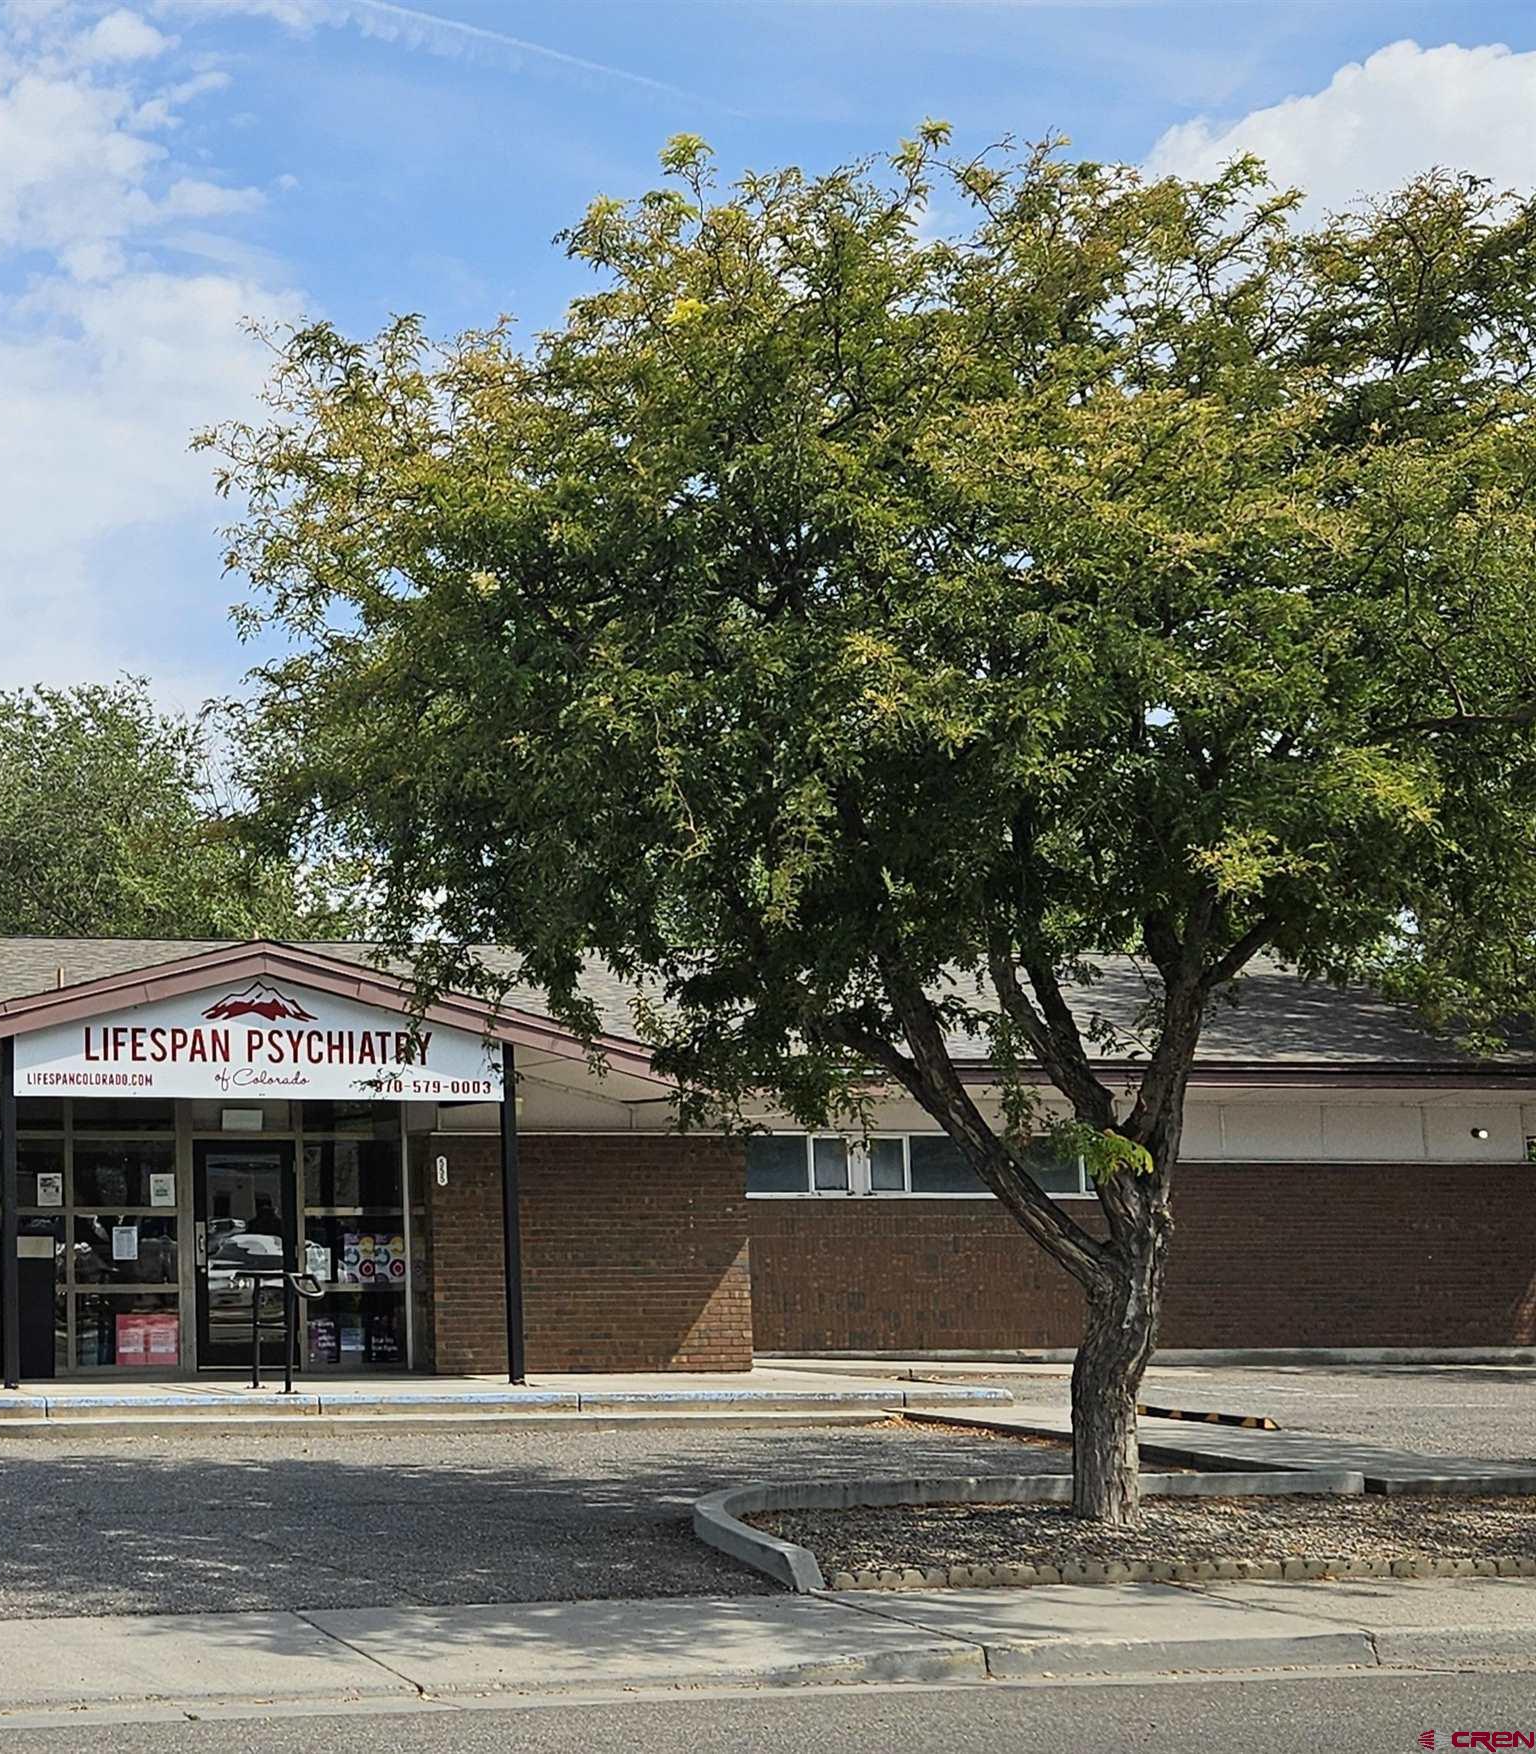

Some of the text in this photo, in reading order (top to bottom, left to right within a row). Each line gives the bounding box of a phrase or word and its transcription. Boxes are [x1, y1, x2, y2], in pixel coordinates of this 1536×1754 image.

[84, 1026, 433, 1066] LIFESPAN PSYCHIATRY
[26, 1072, 154, 1087] LIFESPANCOLORADO.COM
[214, 1067, 311, 1092] of Colorado
[374, 1079, 492, 1095] 970-579-0003
